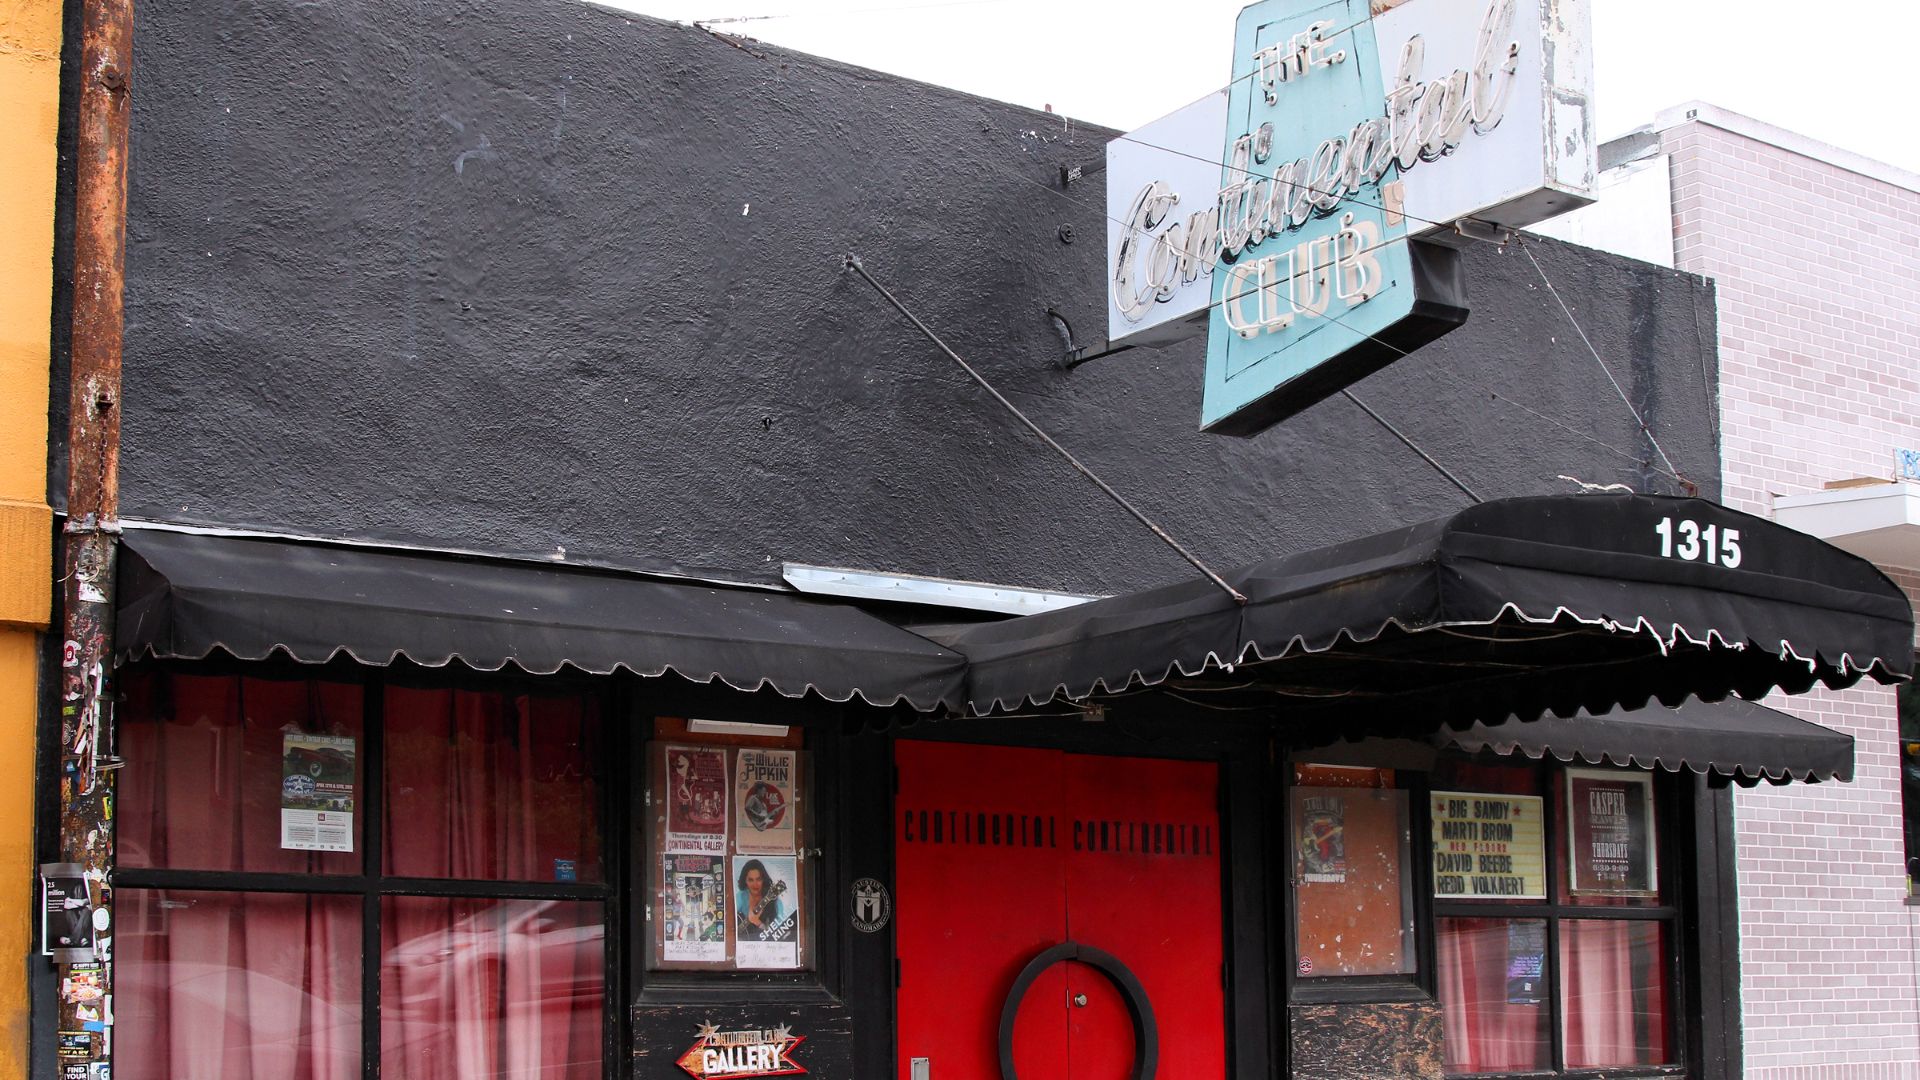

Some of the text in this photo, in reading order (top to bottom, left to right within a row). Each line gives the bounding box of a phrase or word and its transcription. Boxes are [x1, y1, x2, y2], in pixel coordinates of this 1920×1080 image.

[1253, 18, 1340, 92] THE
[1114, 0, 1519, 323] Continental
[1222, 215, 1384, 339] CLUB
[1656, 517, 1741, 568] 1315
[756, 753, 789, 767] WILLIE
[740, 763, 788, 781] PIPKIN
[1449, 800, 1509, 820] BIG SANDY
[1590, 792, 1626, 815] CASPER
[1442, 822, 1513, 841] MARTI BROM
[668, 840, 724, 851] CONTINENTAL GALLERY
[1592, 843, 1628, 858] THURSDAYS
[1437, 852, 1512, 873] DAVID BEEBE
[856, 879, 881, 889] AUSTIN
[1437, 876, 1524, 895] REDD VOLKAERT
[772, 918, 795, 941] KING
[852, 918, 884, 931] LANDMARK
[703, 1044, 784, 1074] GALLERY
